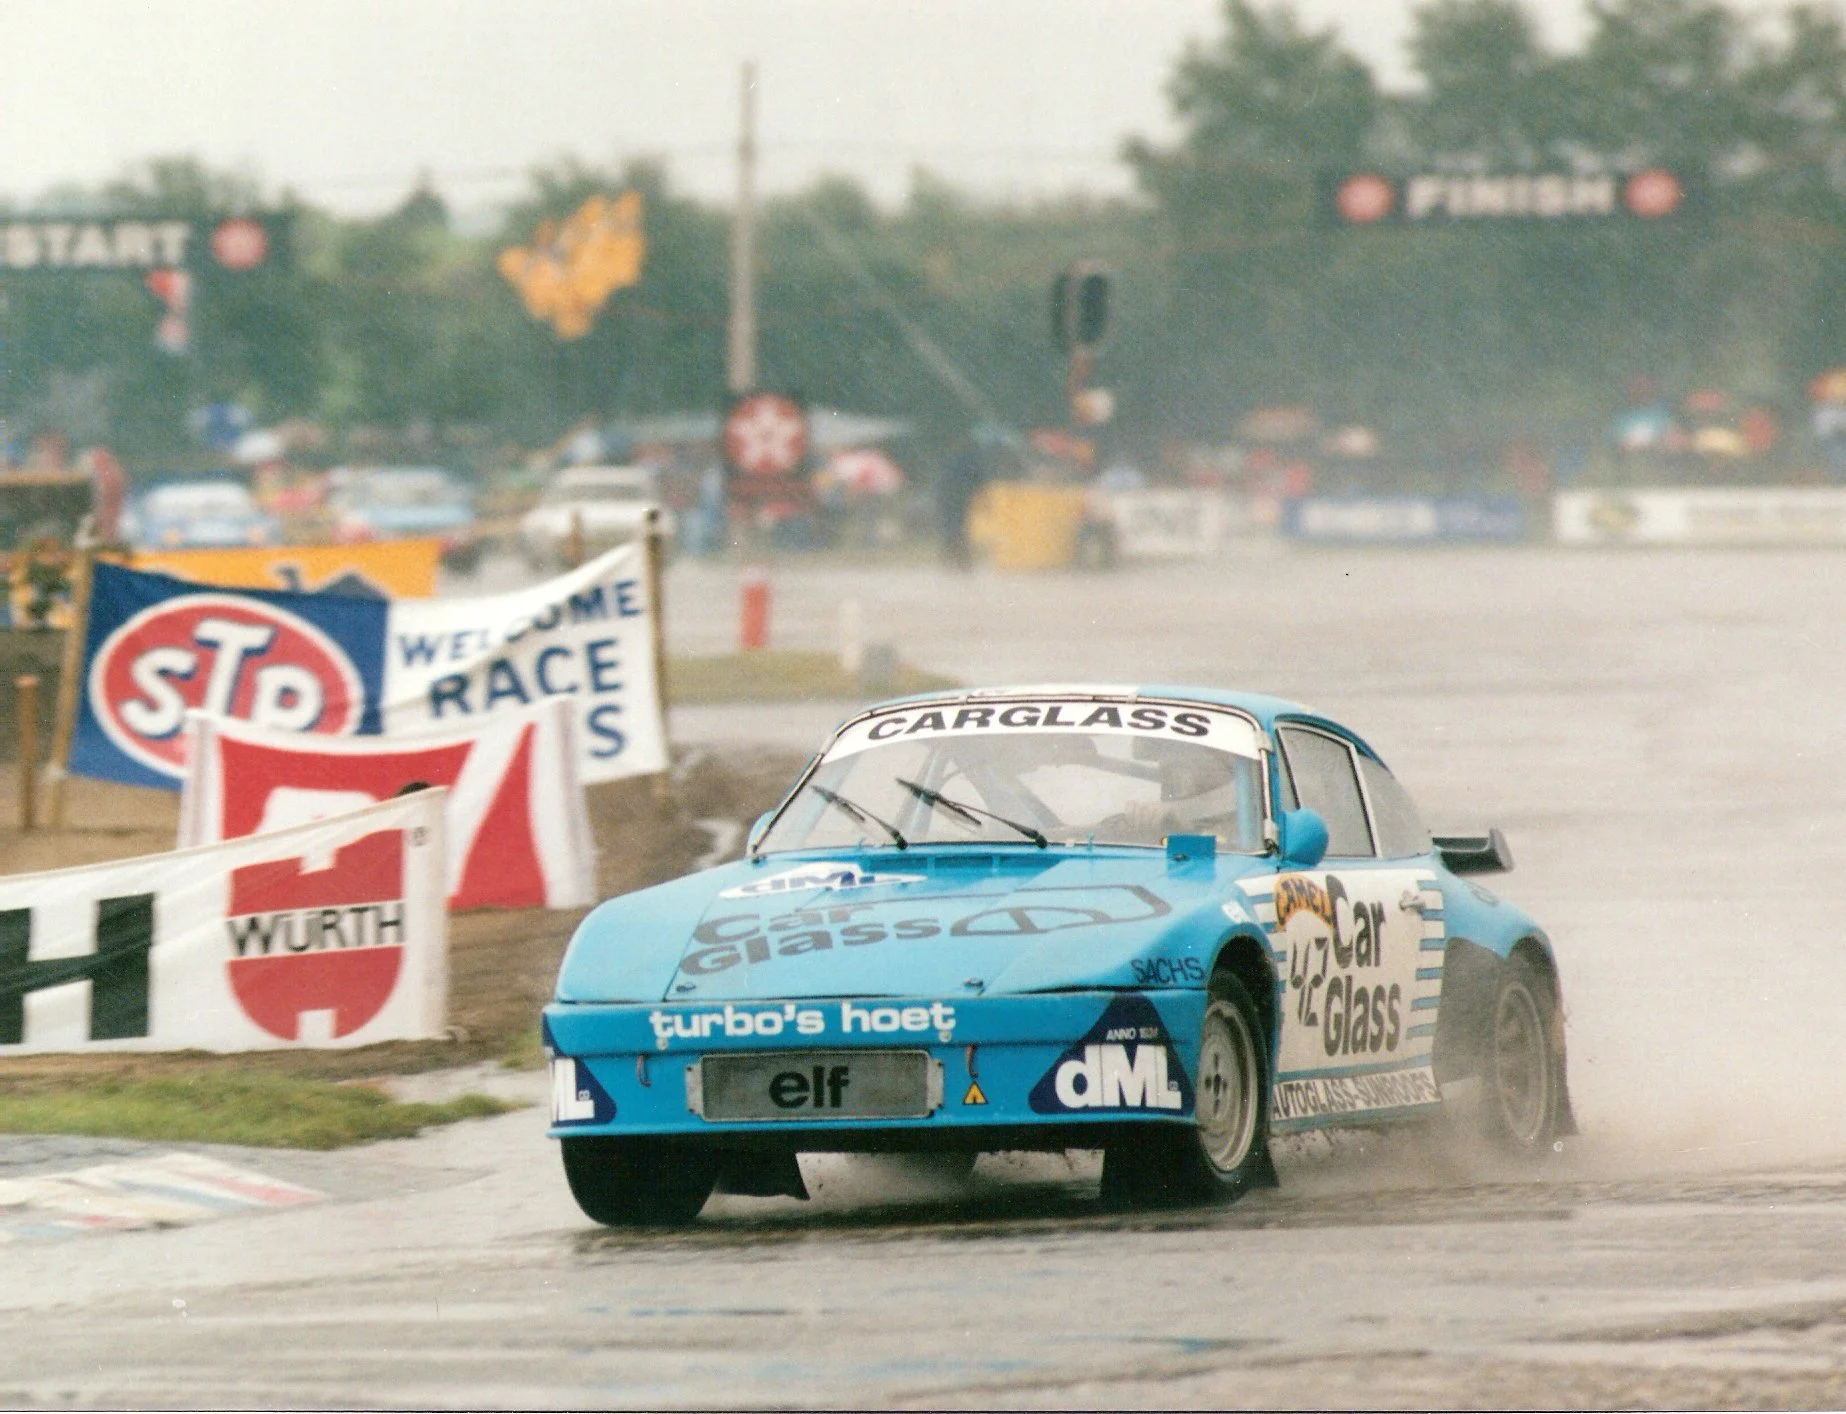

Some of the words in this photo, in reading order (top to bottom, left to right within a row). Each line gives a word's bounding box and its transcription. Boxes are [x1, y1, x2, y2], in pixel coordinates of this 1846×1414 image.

[118, 618, 323, 738] STP
[429, 638, 623, 719] RACE
[867, 705, 1211, 741] CARGLASS
[693, 906, 875, 945] Car
[1326, 874, 1386, 969] Car
[680, 918, 942, 976] Glass
[1131, 956, 1207, 985] SACHS
[650, 1004, 826, 1038] turbo's
[841, 1002, 956, 1033] hoet
[1106, 1027, 1137, 1041] ANNO
[1323, 975, 1401, 1057] Glass
[769, 1065, 849, 1109] elf
